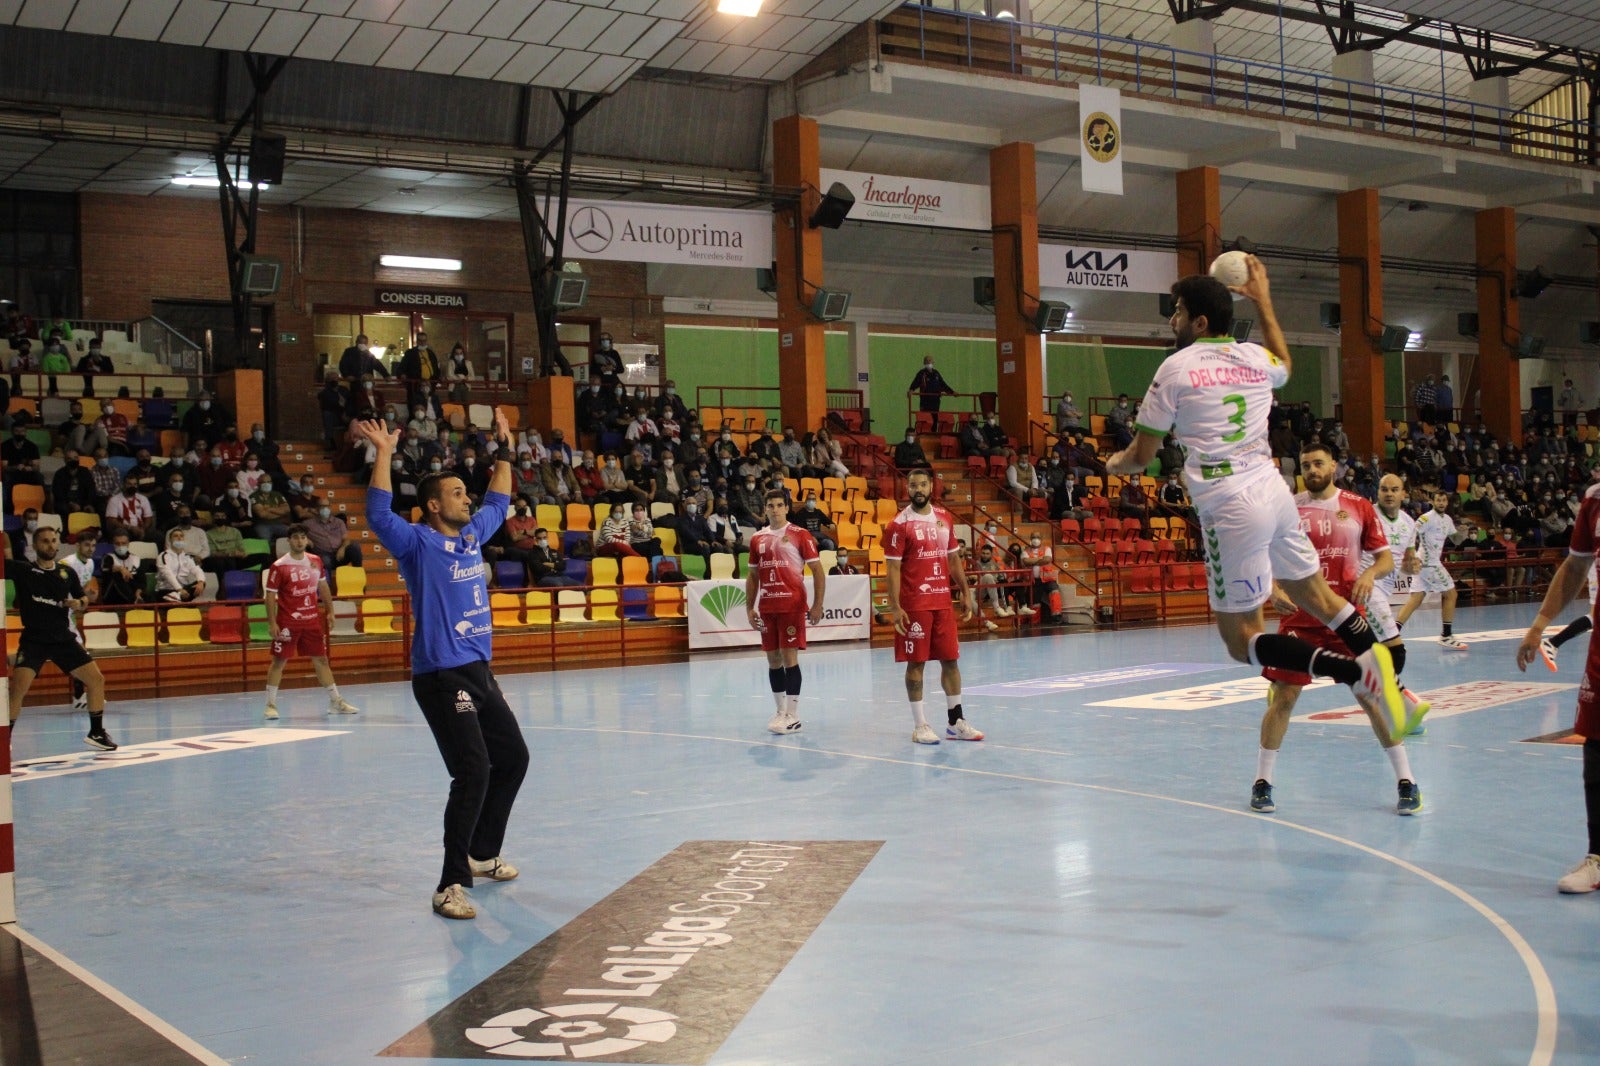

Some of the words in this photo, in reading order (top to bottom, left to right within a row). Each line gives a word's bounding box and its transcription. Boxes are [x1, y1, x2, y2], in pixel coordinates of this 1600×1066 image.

[862, 176, 941, 213] Incarlopsa
[620, 218, 743, 250] Autoprima
[689, 250, 743, 262] Mercedes-Benz
[1066, 271, 1129, 287] AUTOZETA
[380, 292, 464, 307] CONSERJERIA
[1188, 368, 1216, 389] DEL
[1221, 393, 1247, 443] 3
[926, 527, 937, 541] 13
[1317, 519, 1332, 537] 18
[298, 568, 310, 581] 25
[904, 640, 914, 654] 13
